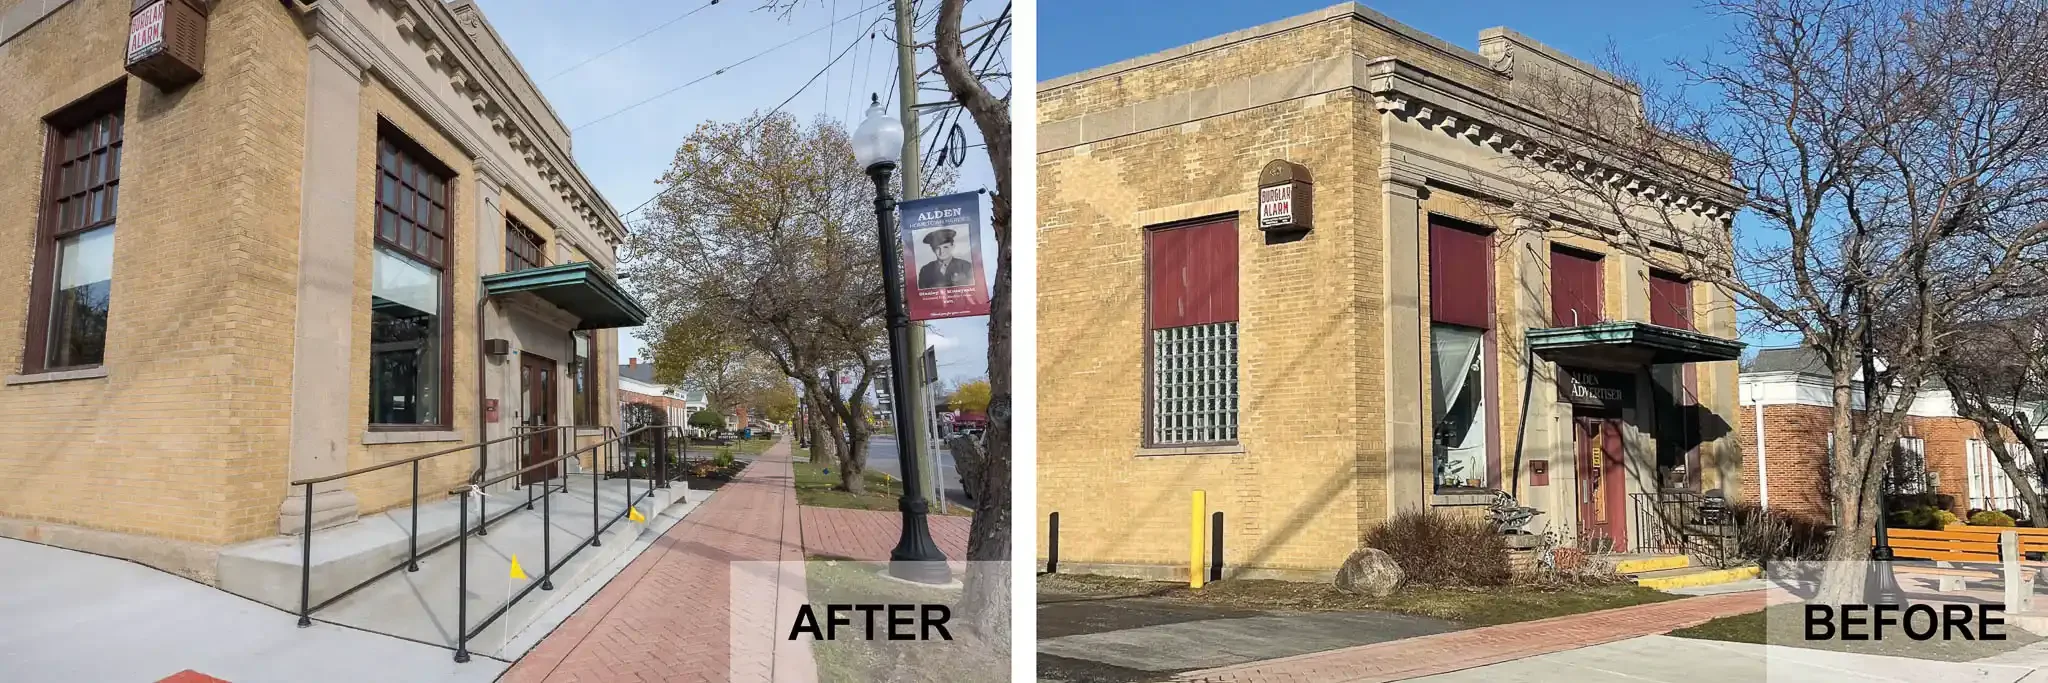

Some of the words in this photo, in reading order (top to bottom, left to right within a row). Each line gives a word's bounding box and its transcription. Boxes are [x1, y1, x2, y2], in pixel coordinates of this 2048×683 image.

[131, 3, 165, 34] BURGLAR
[131, 22, 160, 52] ALARM
[1261, 186, 1291, 204] BURGLAR
[918, 207, 962, 221] ALDEN
[1263, 202, 1289, 217] ALARM
[1570, 371, 1599, 386] ALDEN
[1571, 383, 1623, 401] ADVERTISER
